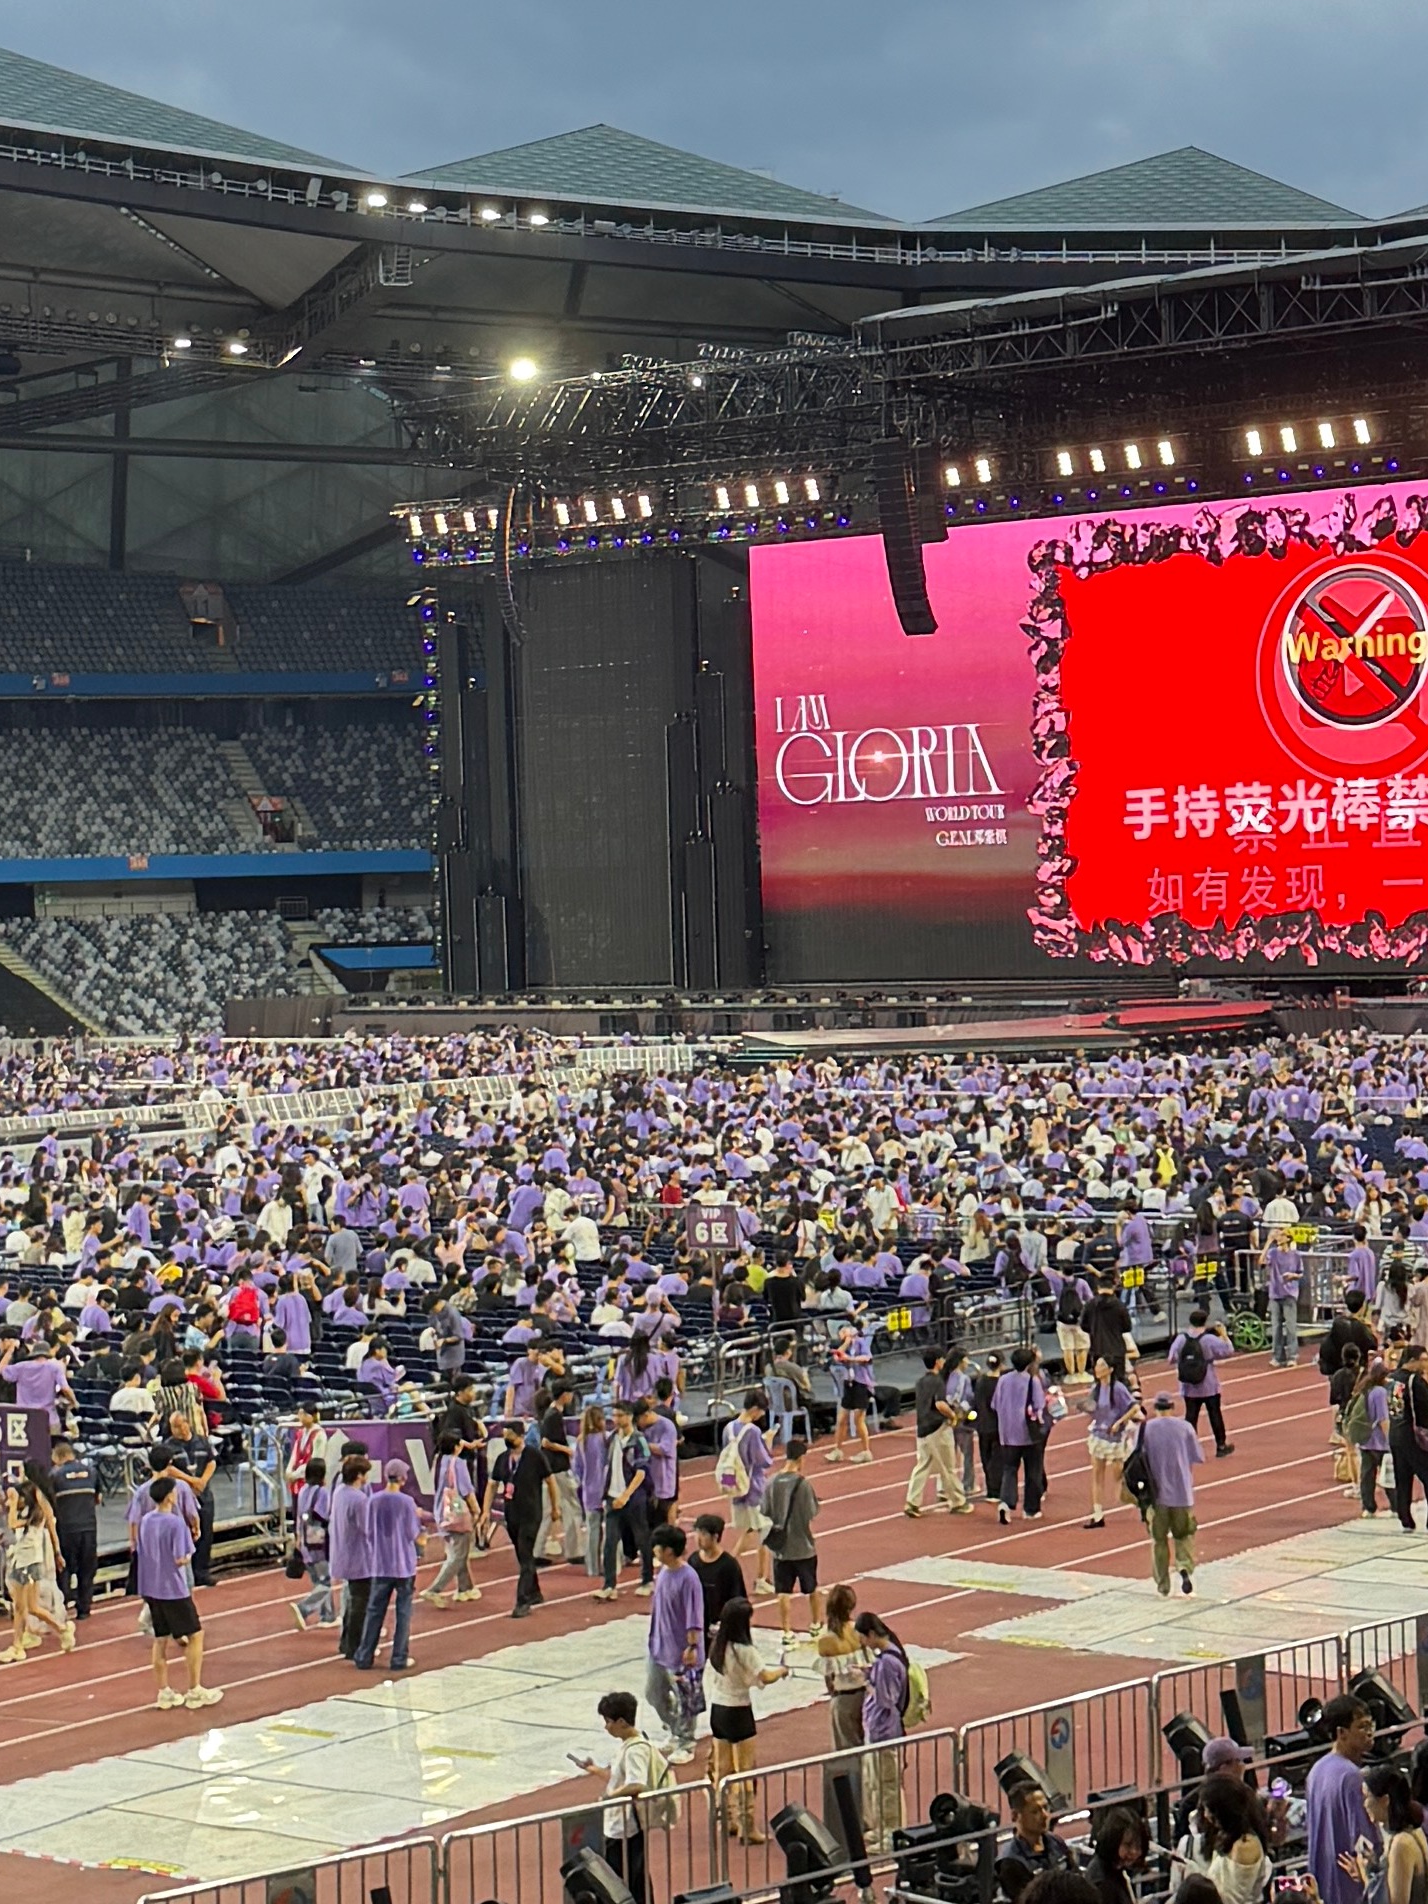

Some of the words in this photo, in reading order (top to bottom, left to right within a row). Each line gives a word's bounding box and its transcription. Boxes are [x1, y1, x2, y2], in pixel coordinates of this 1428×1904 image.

[1287, 625, 1427, 664] Warning
[775, 696, 784, 733] I
[775, 722, 1006, 806] GLORIA
[972, 804, 1005, 821] TOUR
[701, 1207, 721, 1219] VIP
[695, 1222, 729, 1244] 6区
